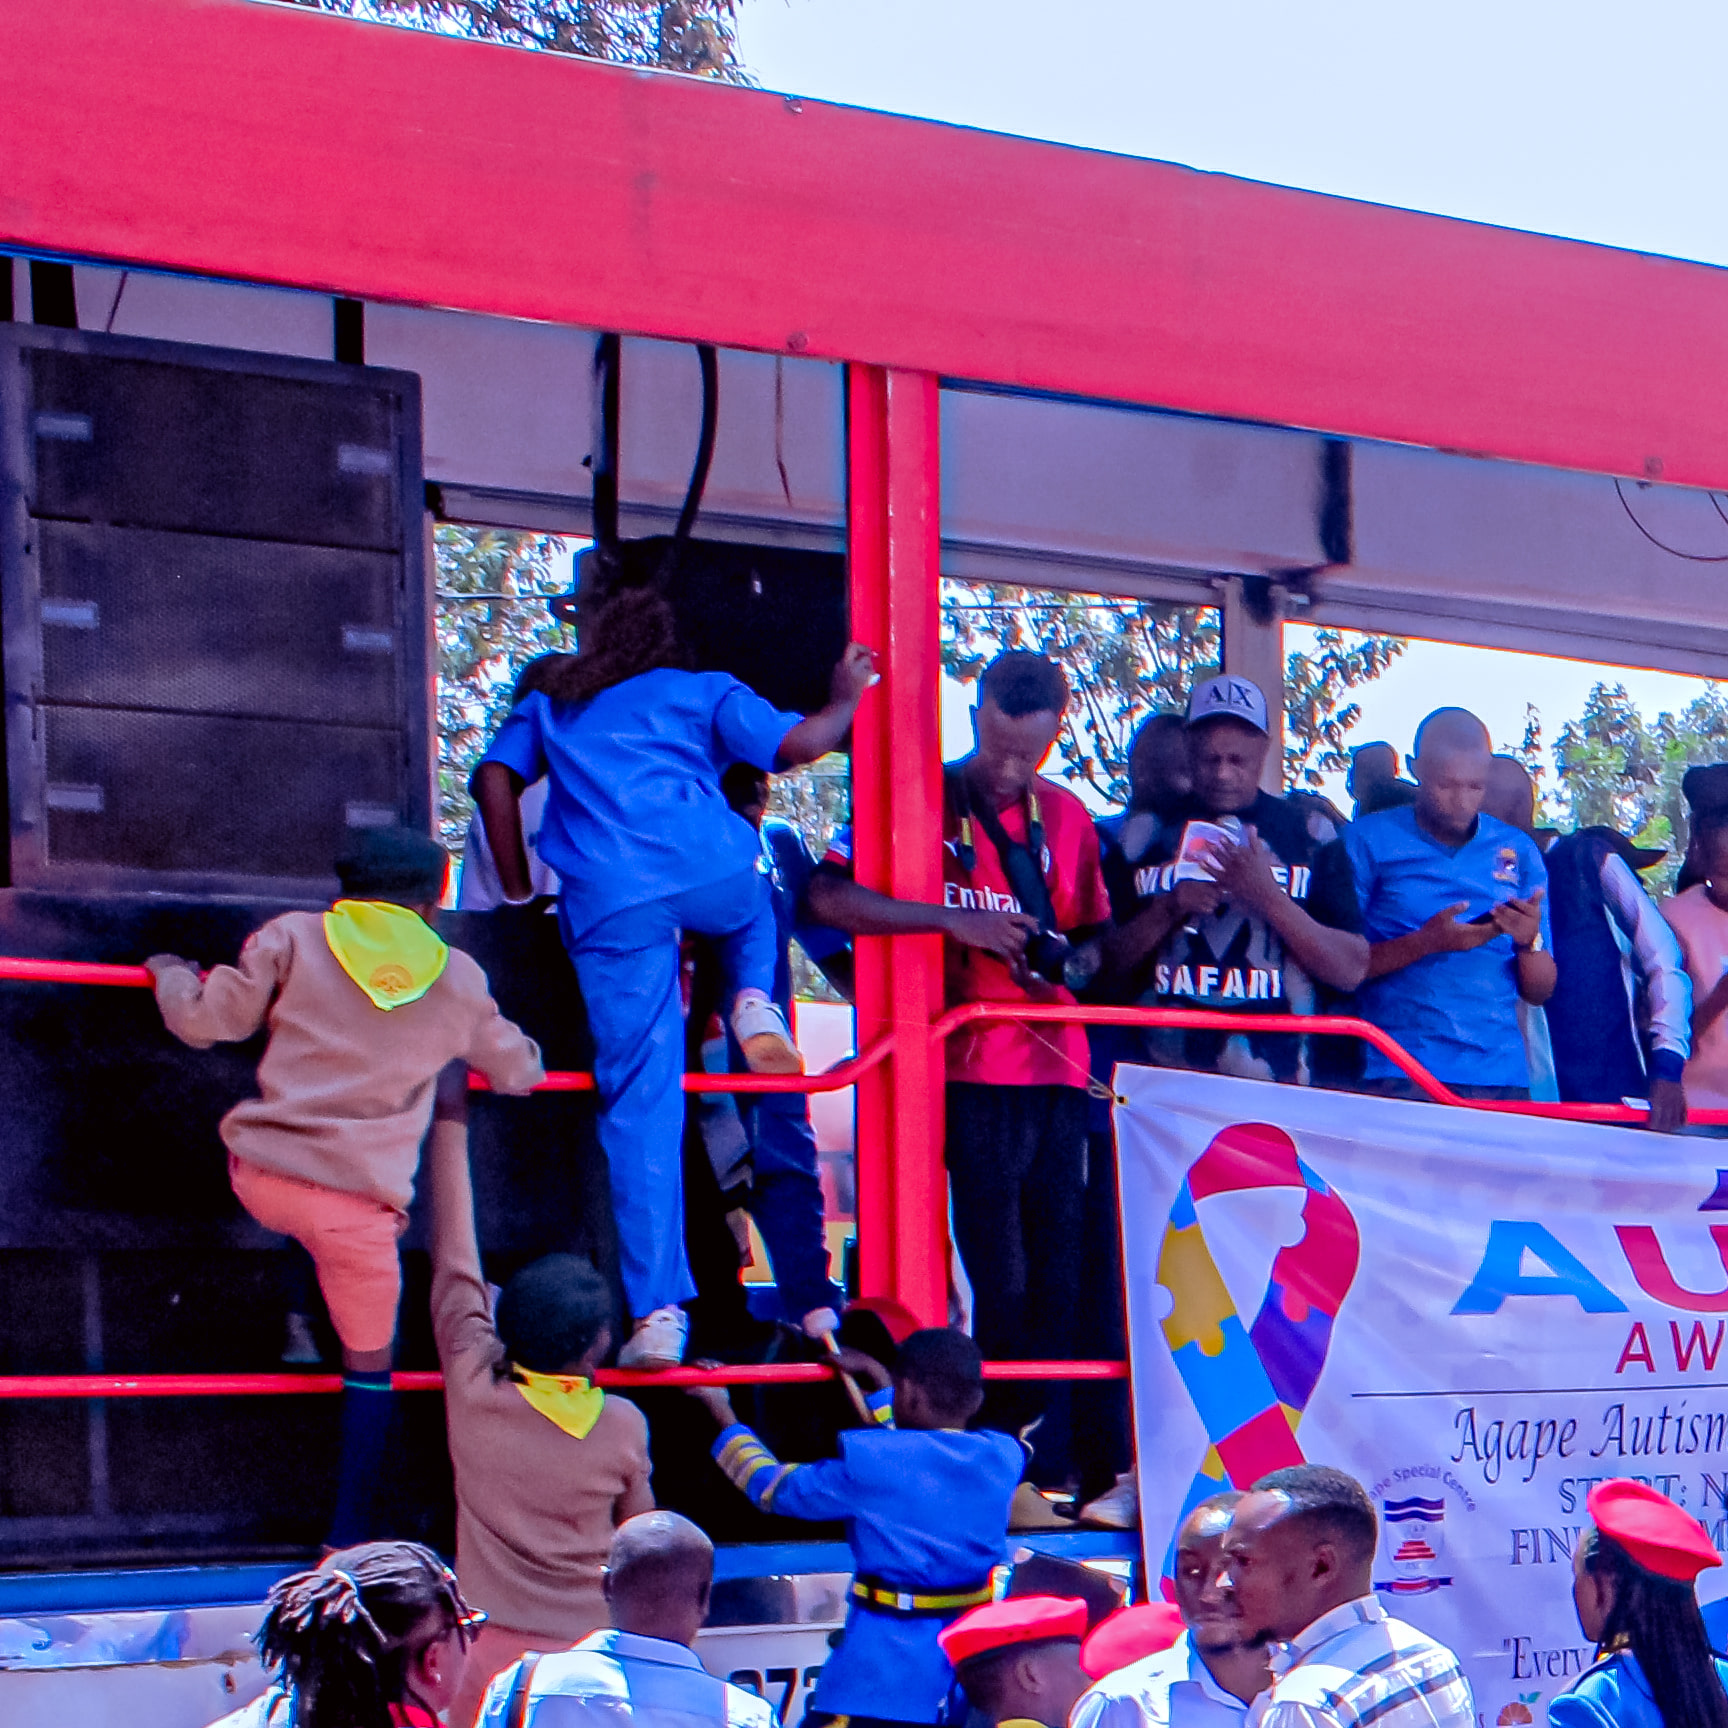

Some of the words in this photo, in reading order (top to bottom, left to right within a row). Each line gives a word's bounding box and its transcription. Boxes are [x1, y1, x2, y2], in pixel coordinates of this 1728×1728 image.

[944, 882, 1022, 913] Emira
[1451, 1407, 1578, 1484] Agape
[1559, 1474, 1688, 1514] STT:
